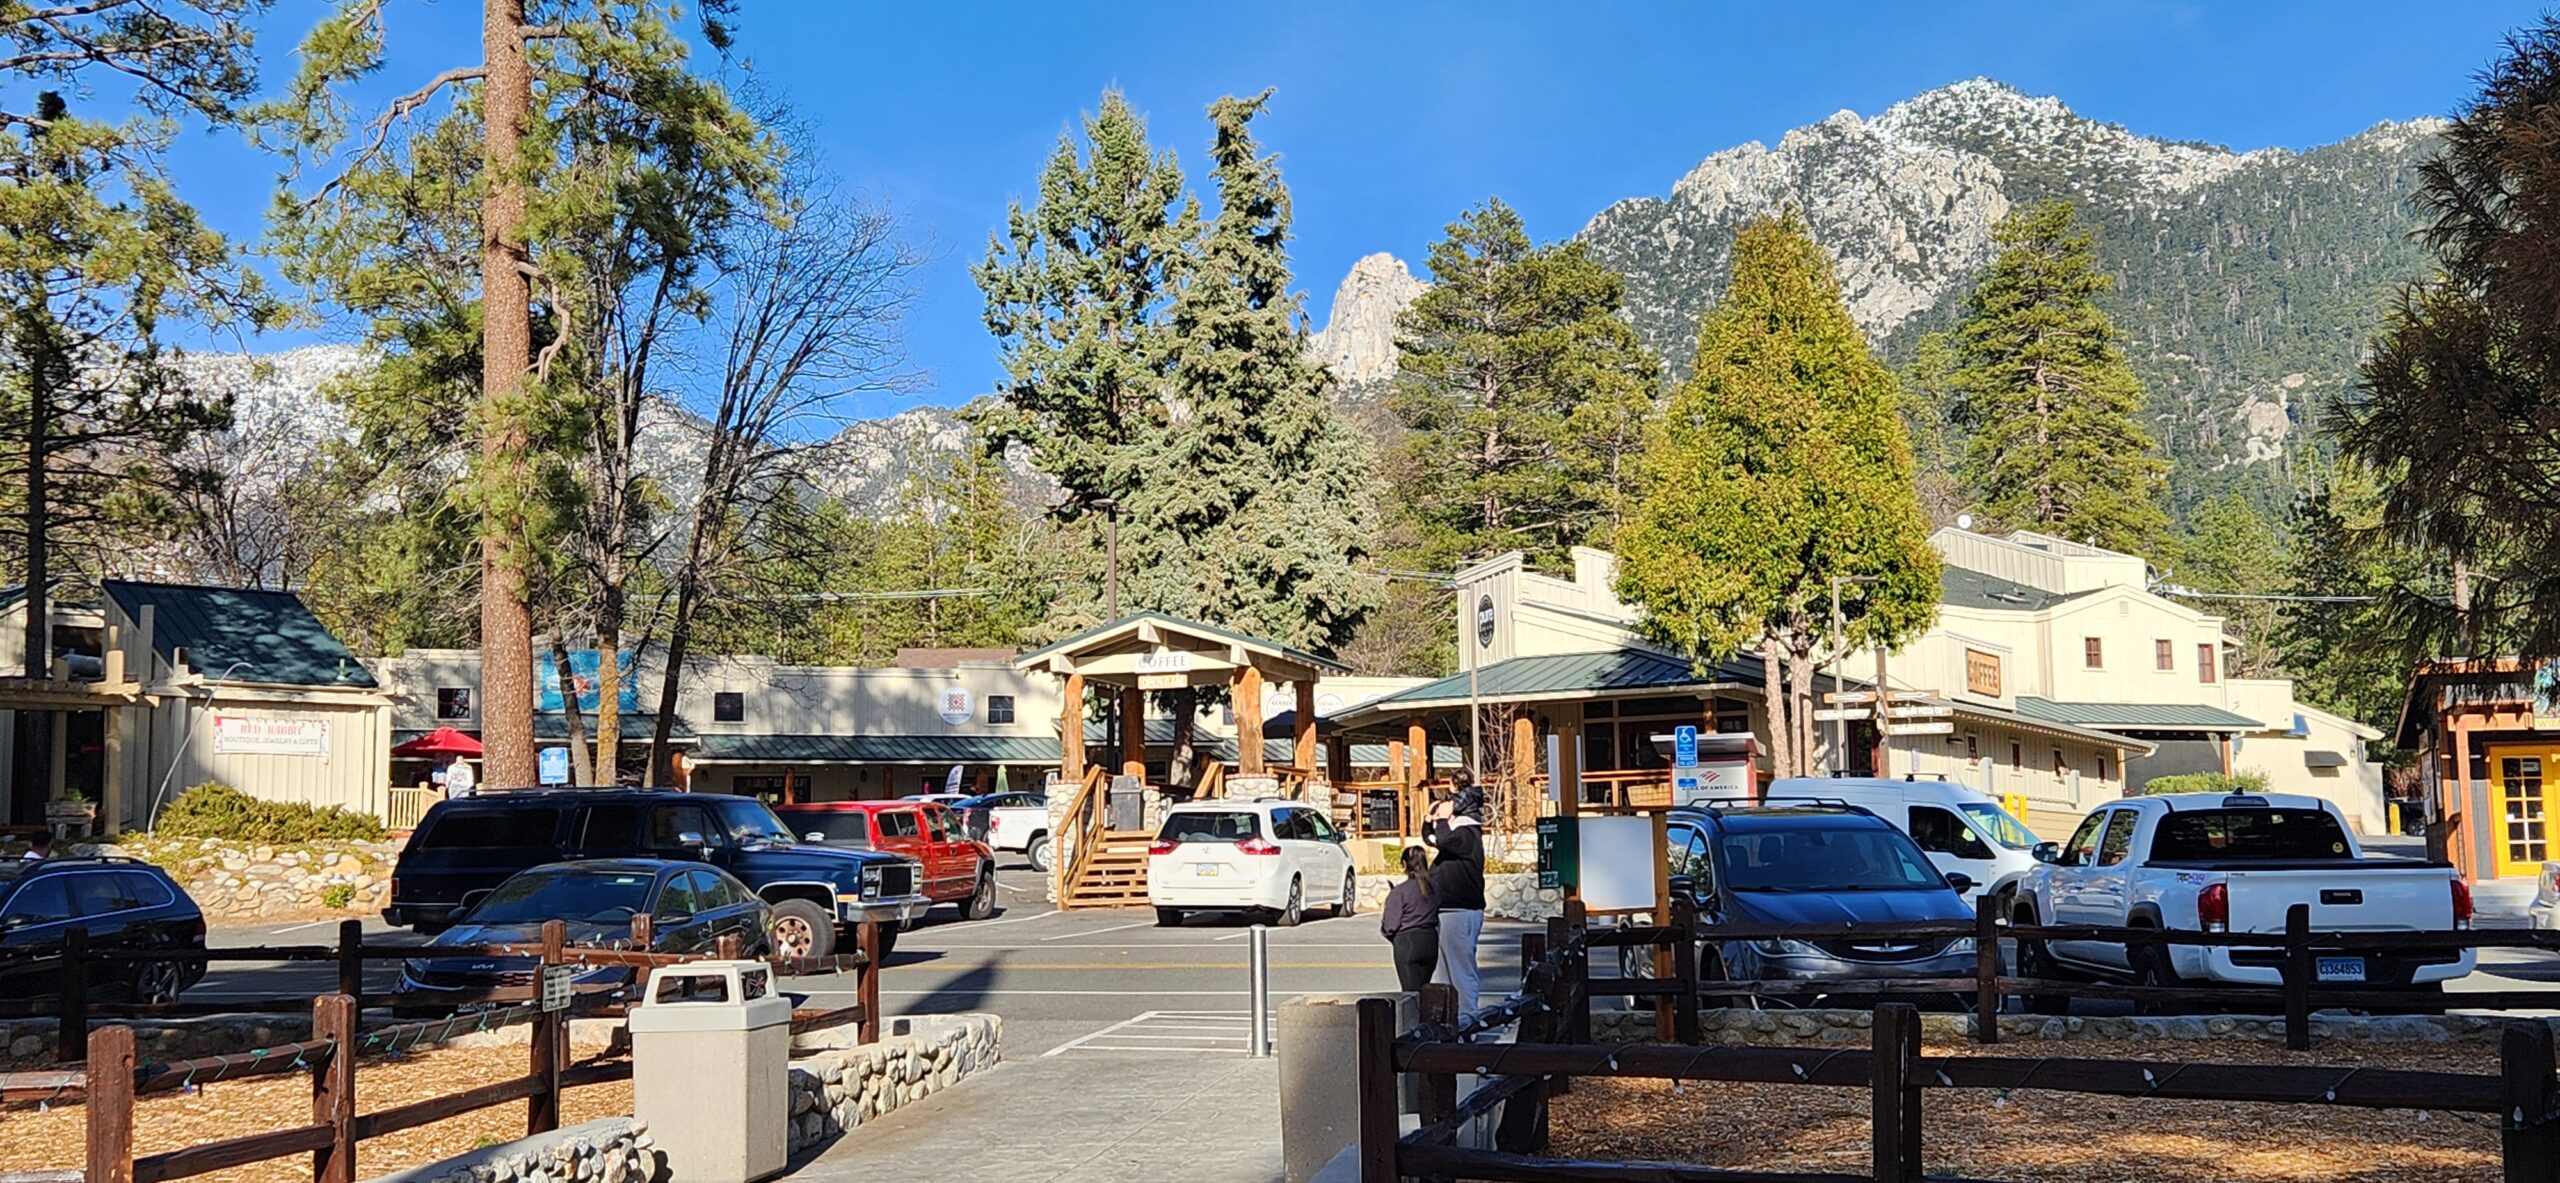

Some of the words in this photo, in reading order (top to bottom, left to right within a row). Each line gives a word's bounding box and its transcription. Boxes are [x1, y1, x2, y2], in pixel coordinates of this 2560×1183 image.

[1139, 655, 1187, 668] COFFEE
[1968, 659, 1998, 689] COFFEE
[240, 724, 261, 735] RED
[267, 724, 303, 736] RABBIT
